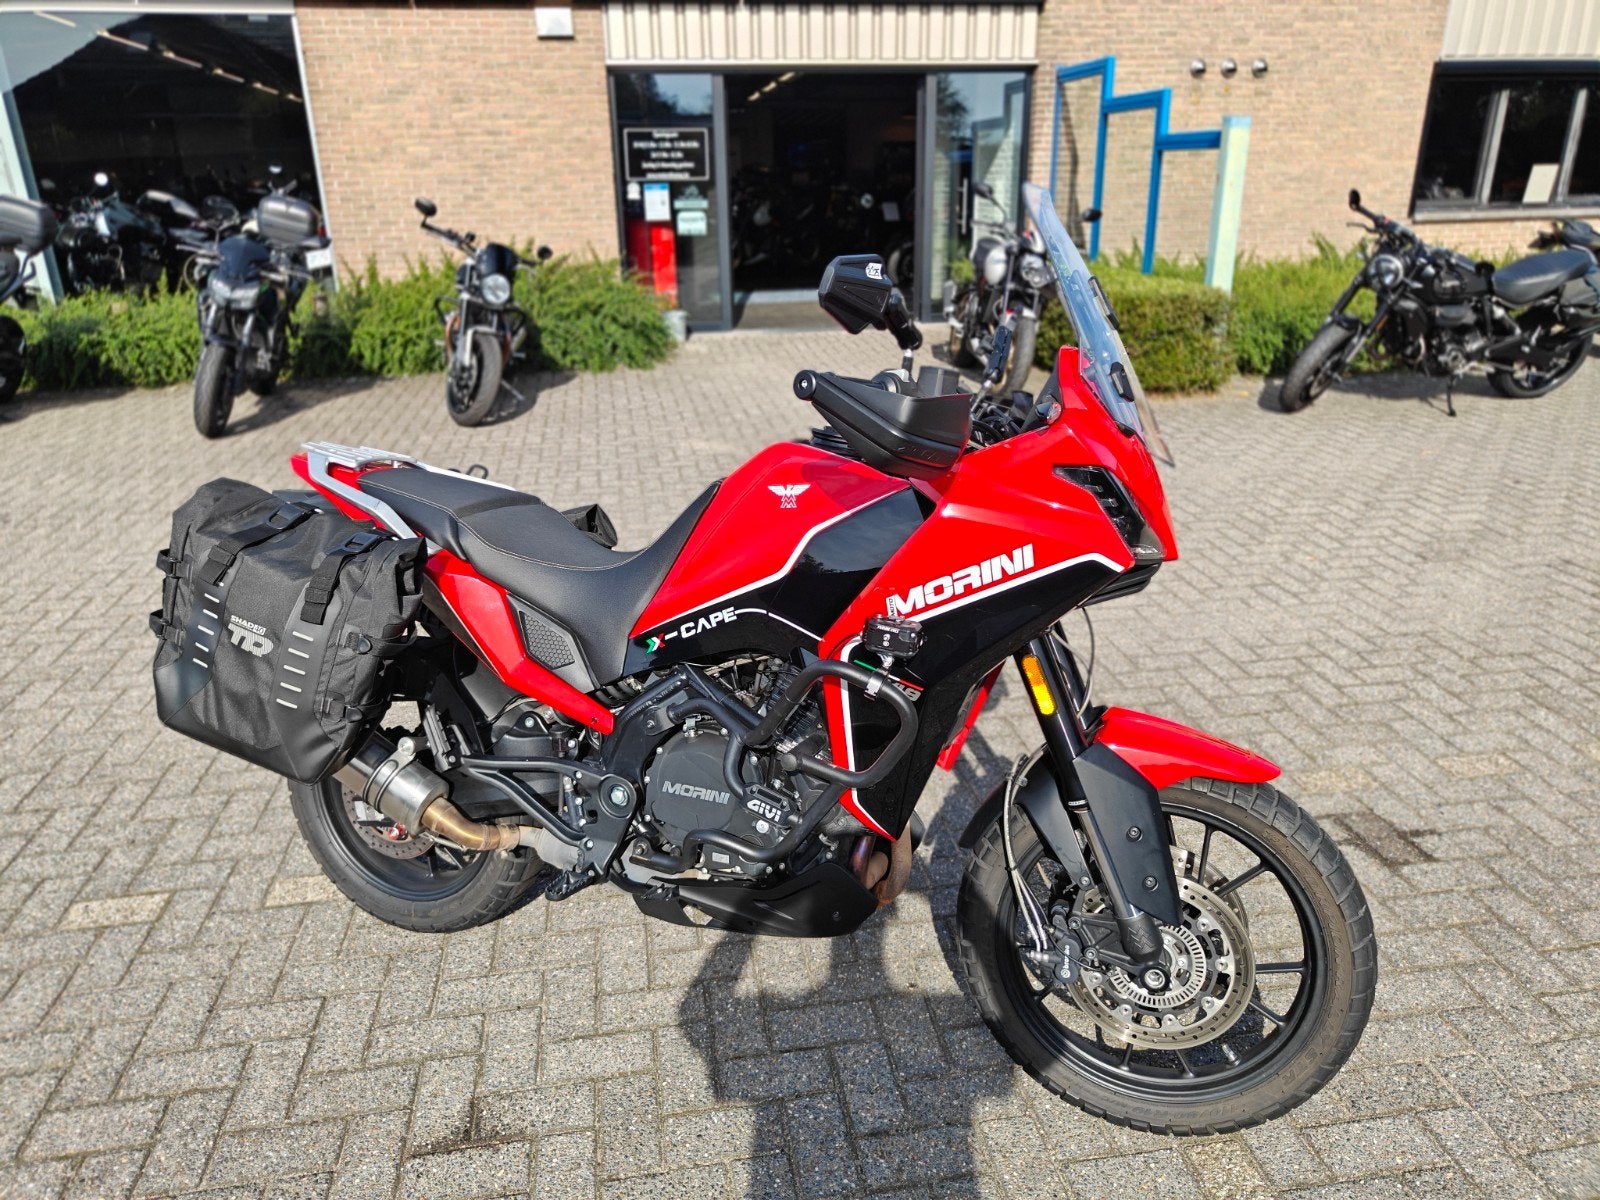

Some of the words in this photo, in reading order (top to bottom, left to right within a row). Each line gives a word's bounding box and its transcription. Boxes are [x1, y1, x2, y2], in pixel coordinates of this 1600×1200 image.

[891, 543, 1035, 615] MORINI
[662, 780, 731, 805] MORINI
[746, 799, 782, 822] GIVI
